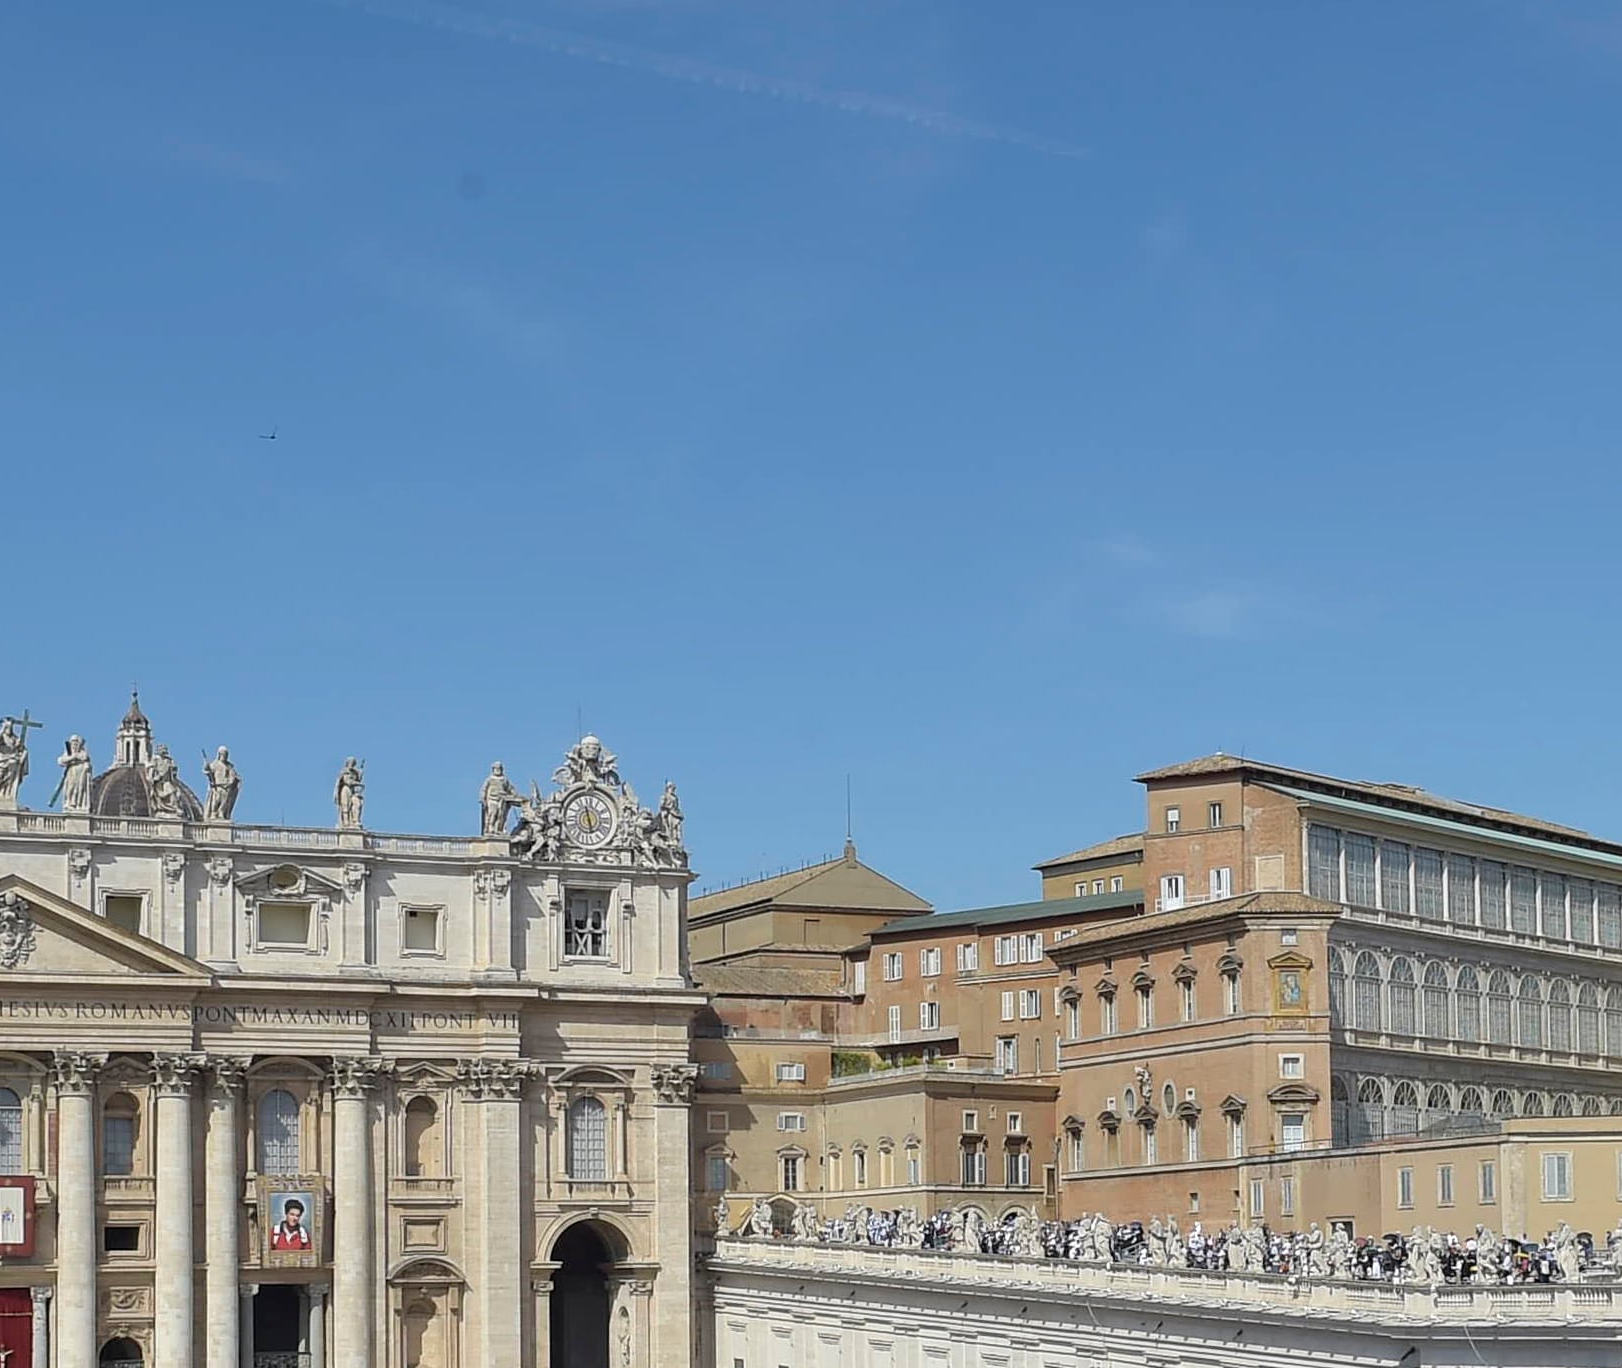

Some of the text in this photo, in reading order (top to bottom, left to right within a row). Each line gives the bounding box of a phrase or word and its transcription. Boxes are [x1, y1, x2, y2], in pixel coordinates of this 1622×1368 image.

[76, 1002, 191, 1020] ROMANVS
[194, 1006, 250, 1023] PONT
[336, 1009, 415, 1028] MDCXII
[422, 1013, 477, 1030] PONT
[487, 1012, 517, 1029] VII
